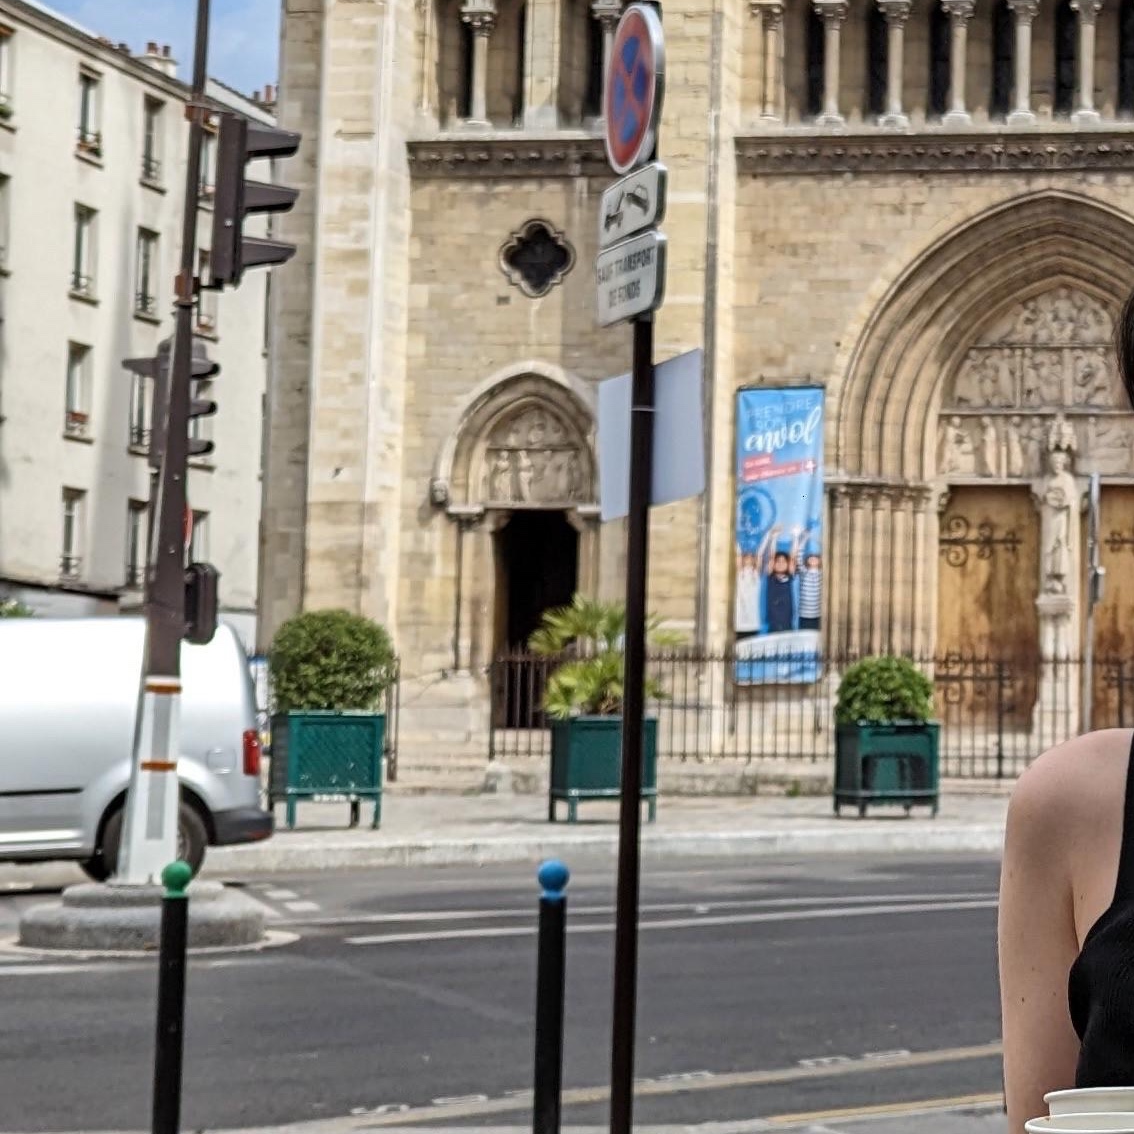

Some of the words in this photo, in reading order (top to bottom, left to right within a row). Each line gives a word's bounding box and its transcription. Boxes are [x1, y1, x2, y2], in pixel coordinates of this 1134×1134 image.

[597, 262, 613, 286] SAUF
[614, 245, 656, 278] TRANSPORT
[618, 278, 641, 304] FONDS
